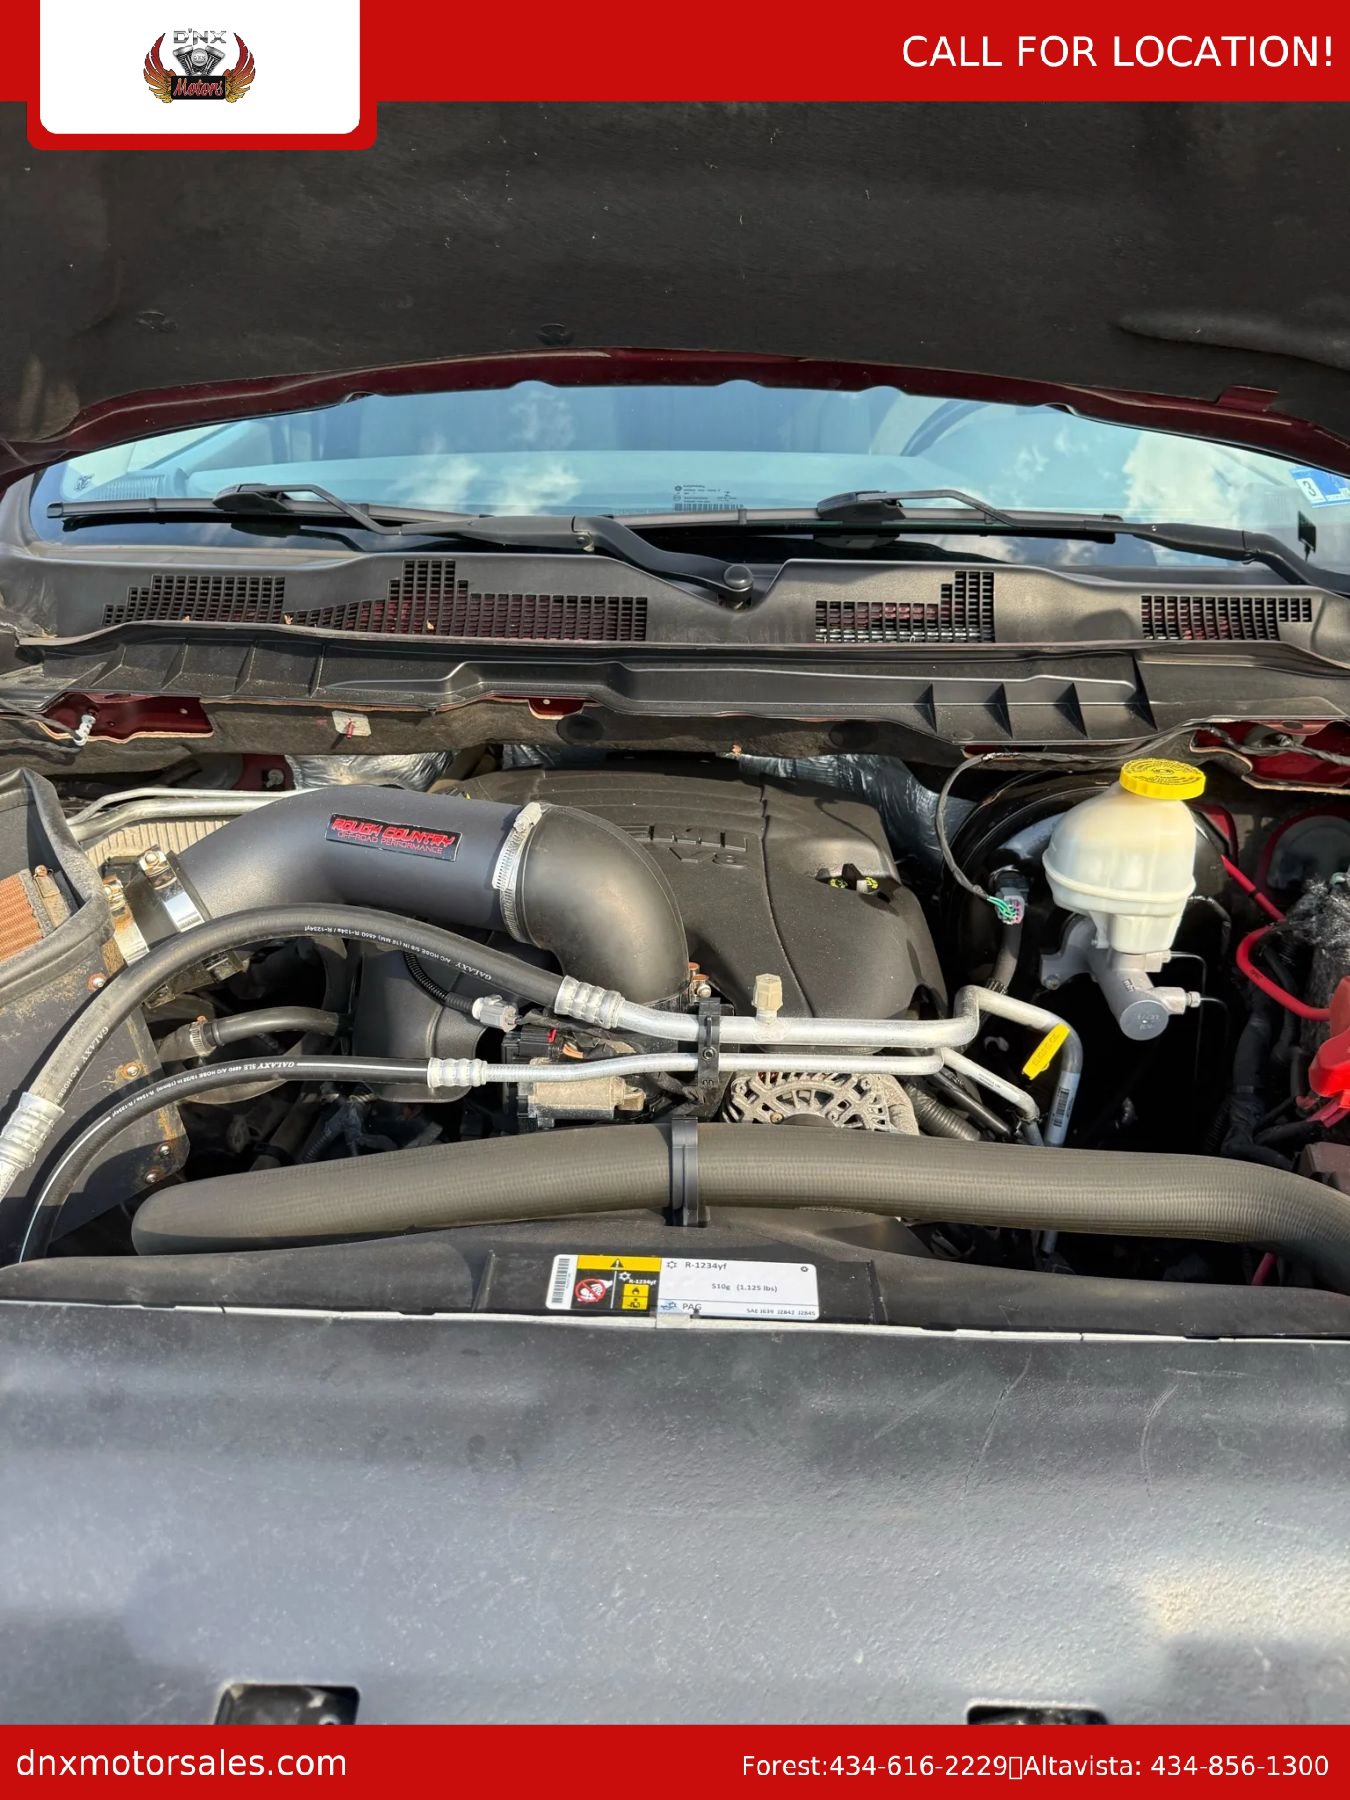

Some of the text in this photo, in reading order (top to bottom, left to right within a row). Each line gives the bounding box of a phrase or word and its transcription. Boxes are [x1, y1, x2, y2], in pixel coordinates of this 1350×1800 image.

[1302, 480, 1317, 497] 3
[331, 818, 456, 848] ROUGH COUNTRY
[380, 837, 444, 854] PERFORMANCE
[421, 948, 439, 959] HOSE
[455, 961, 492, 981] GALAXY
[80, 1026, 109, 1063] GALAXY
[256, 1061, 295, 1070] GALAXY
[684, 1261, 727, 1271] R-1234yf
[736, 1284, 762, 1292] (1.125
[763, 1285, 778, 1293] lbs)
[682, 1303, 702, 1311] PAG
